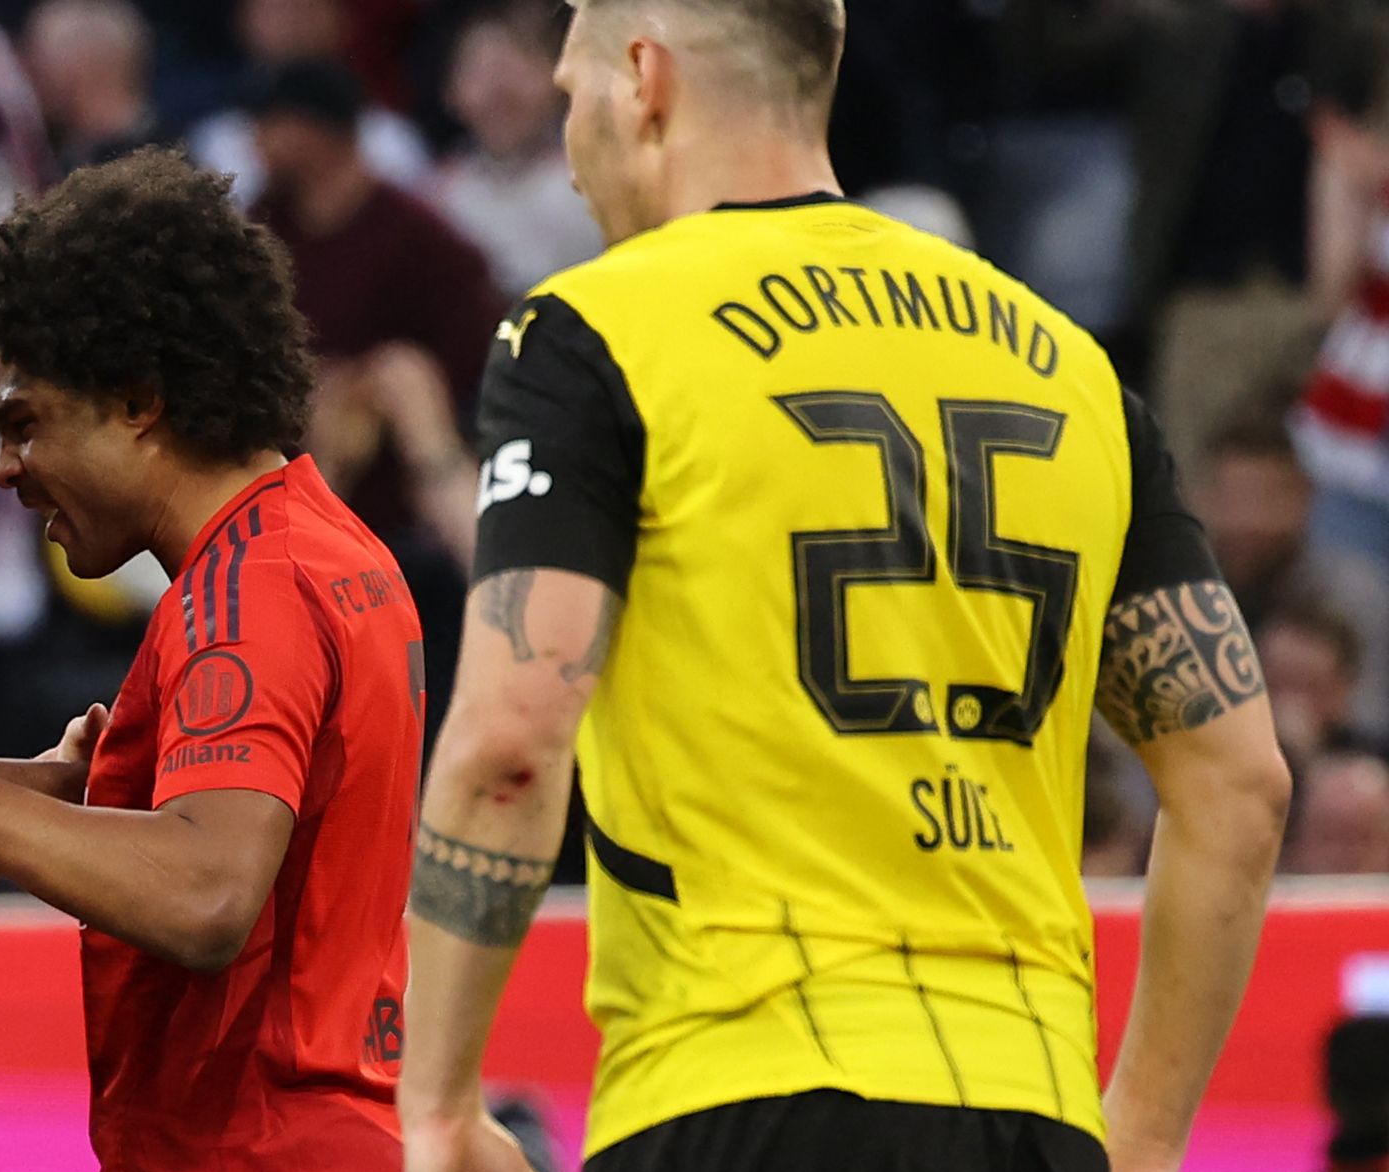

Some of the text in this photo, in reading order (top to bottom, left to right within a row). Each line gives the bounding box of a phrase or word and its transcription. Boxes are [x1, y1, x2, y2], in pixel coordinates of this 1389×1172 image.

[710, 264, 1059, 378] DORTMUND
[766, 390, 1081, 748] 25
[160, 743, 252, 778] Allianz
